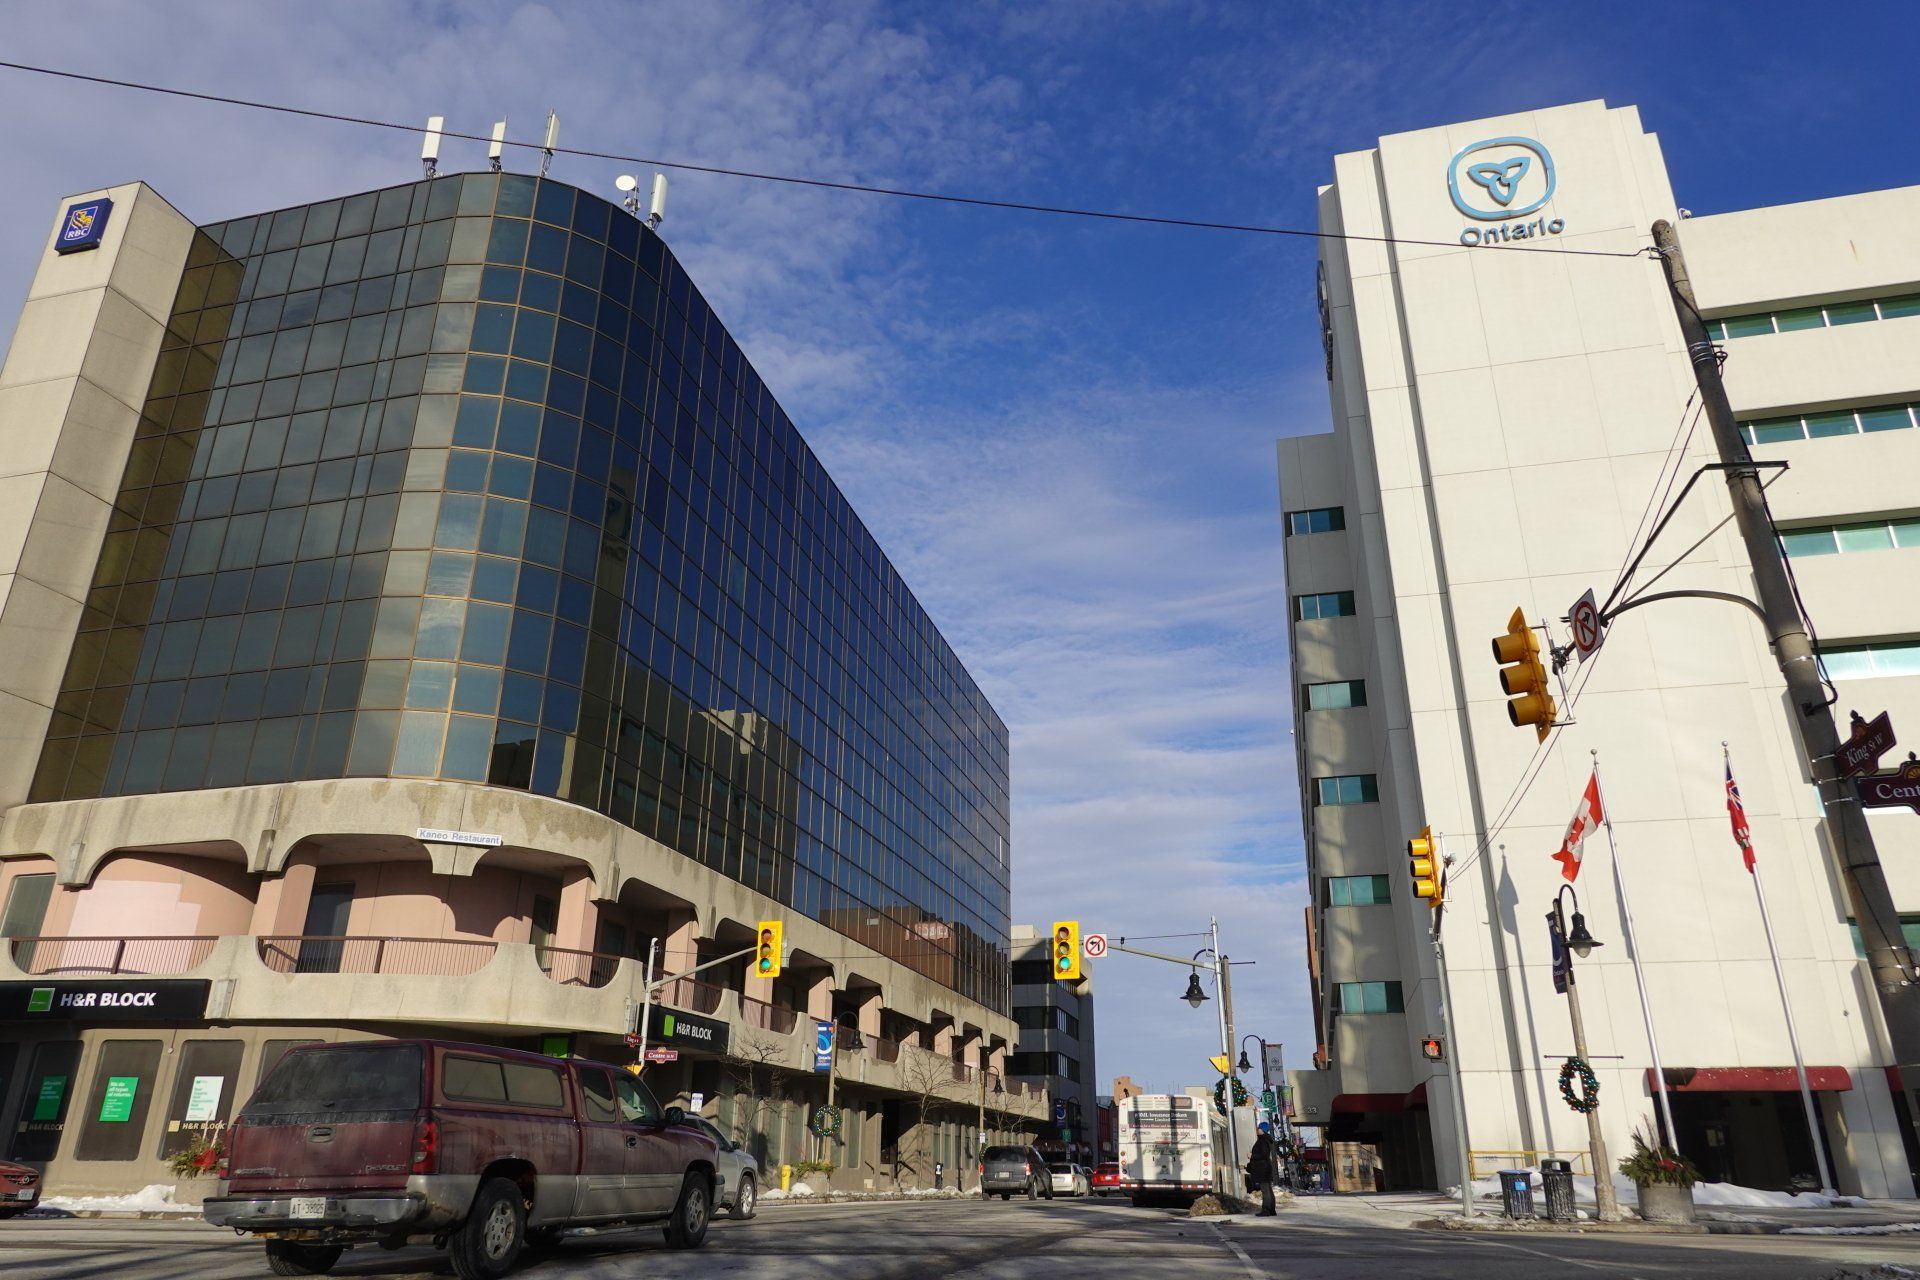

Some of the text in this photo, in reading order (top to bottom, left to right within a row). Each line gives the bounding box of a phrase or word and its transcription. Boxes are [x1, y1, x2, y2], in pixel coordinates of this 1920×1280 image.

[67, 228, 88, 239] RBC
[1460, 216, 1565, 247] Ontario
[1846, 744, 1869, 767] King
[1876, 783, 1920, 799] Cent
[420, 829, 499, 845] Kaneo Restaurant
[60, 992, 157, 1007] H&R BLOCK
[676, 1022, 713, 1041] H&R BLOCK
[182, 1122, 226, 1130] H&R BLOCK
